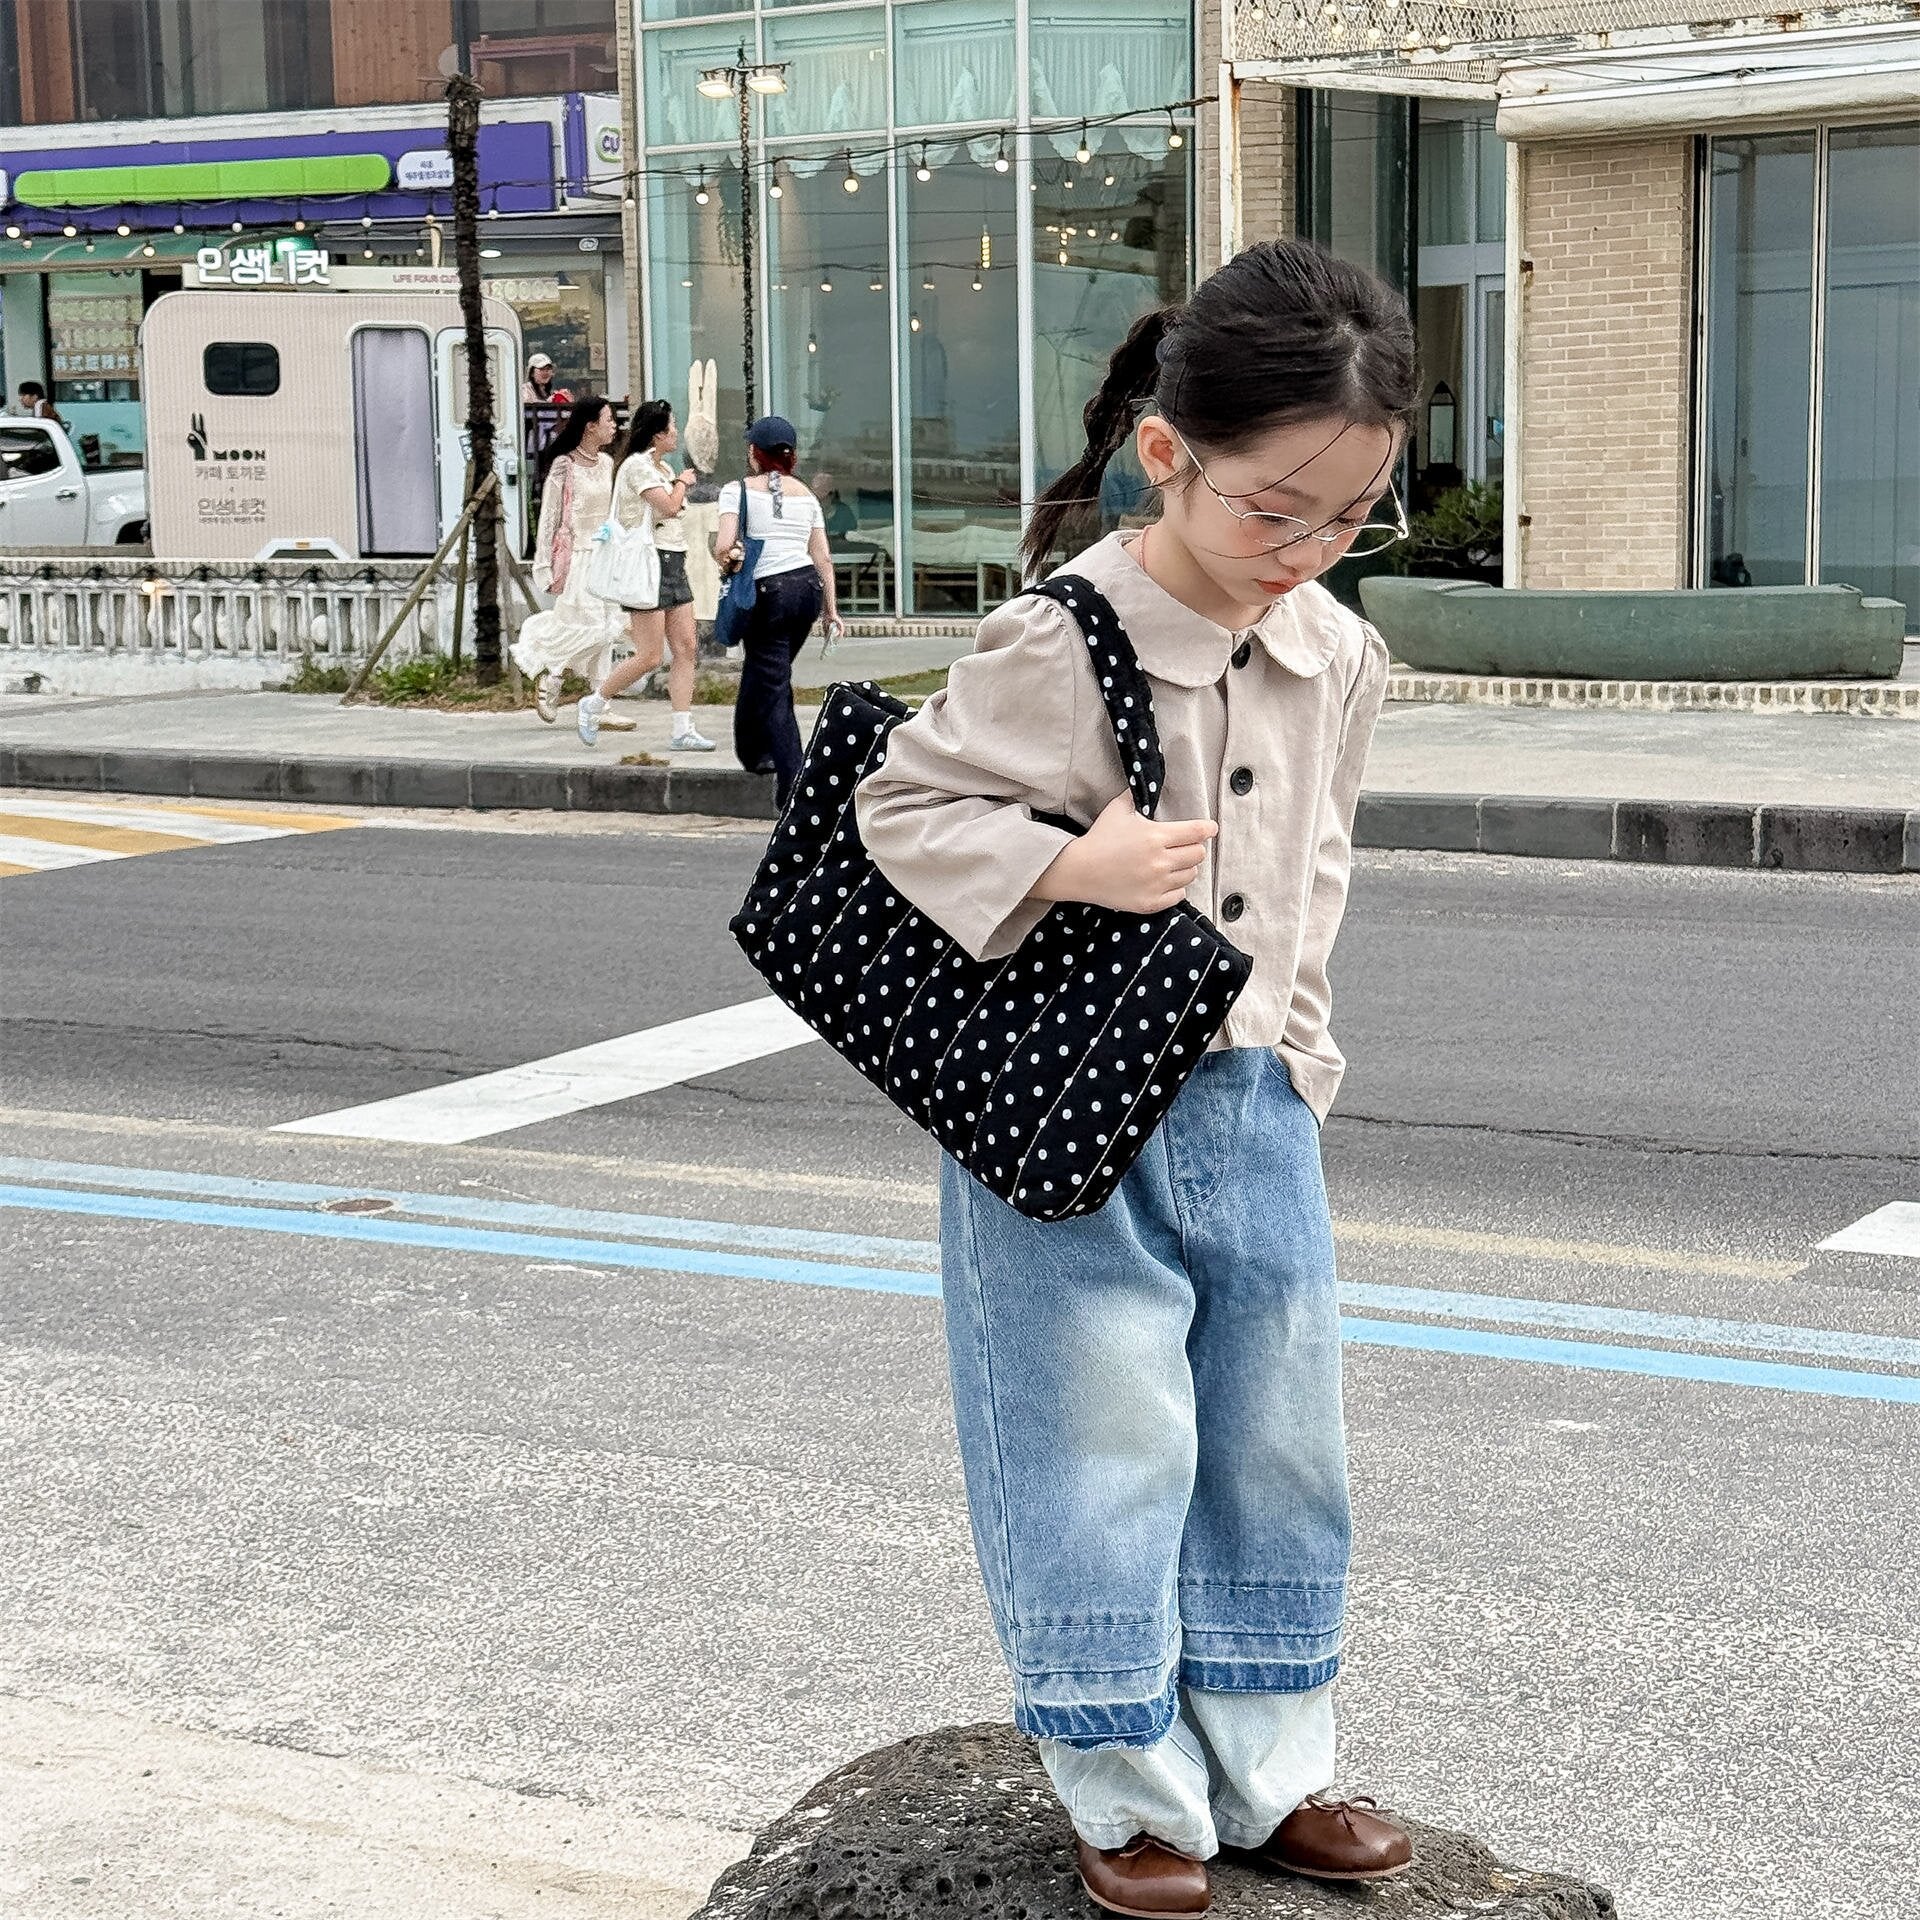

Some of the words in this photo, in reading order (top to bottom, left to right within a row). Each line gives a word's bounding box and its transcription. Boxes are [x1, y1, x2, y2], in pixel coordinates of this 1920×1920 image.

[602, 135, 620, 153] CU
[393, 274, 412, 284] LIFE
[414, 274, 438, 284] FOUR
[439, 274, 460, 284] CUT
[195, 465, 222, 480] 카페
